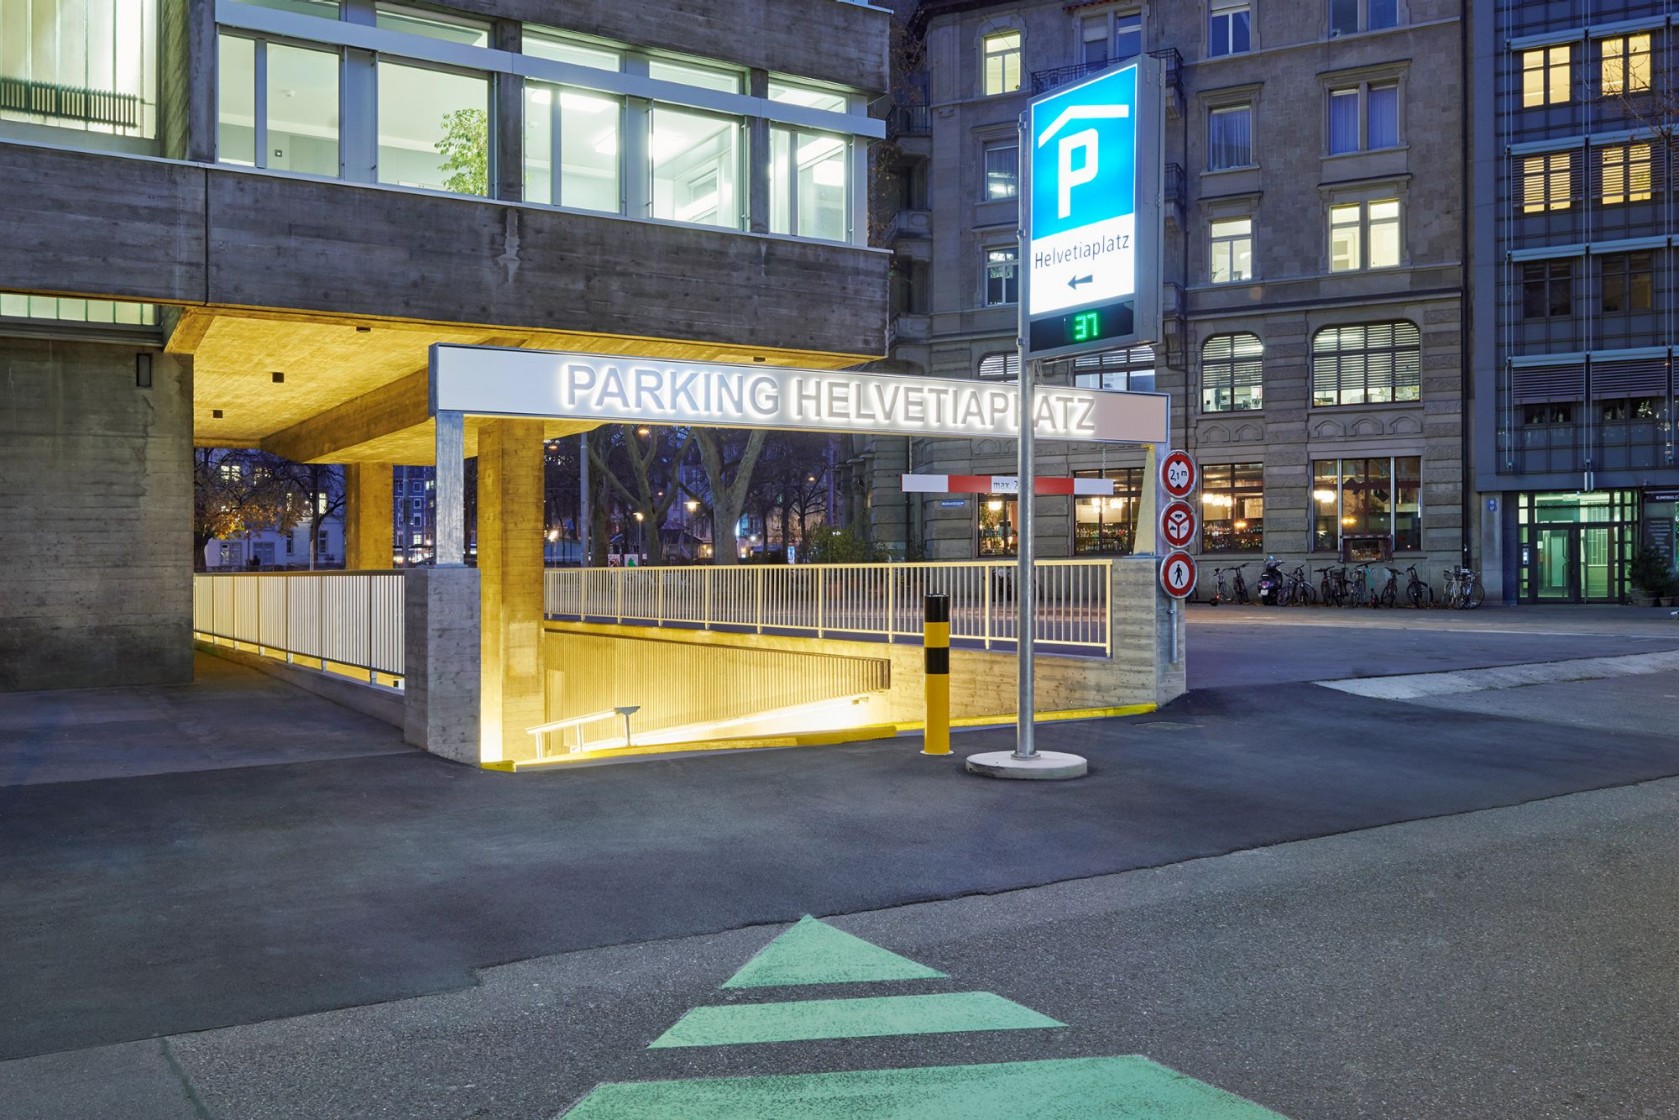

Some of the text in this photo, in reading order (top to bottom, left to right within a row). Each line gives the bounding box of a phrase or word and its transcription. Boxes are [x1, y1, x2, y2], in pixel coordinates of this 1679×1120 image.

[1058, 128, 1099, 219] P
[1035, 234, 1130, 269] Helvetiaplatz
[1075, 312, 1098, 341] 37
[568, 364, 779, 416] PARKING
